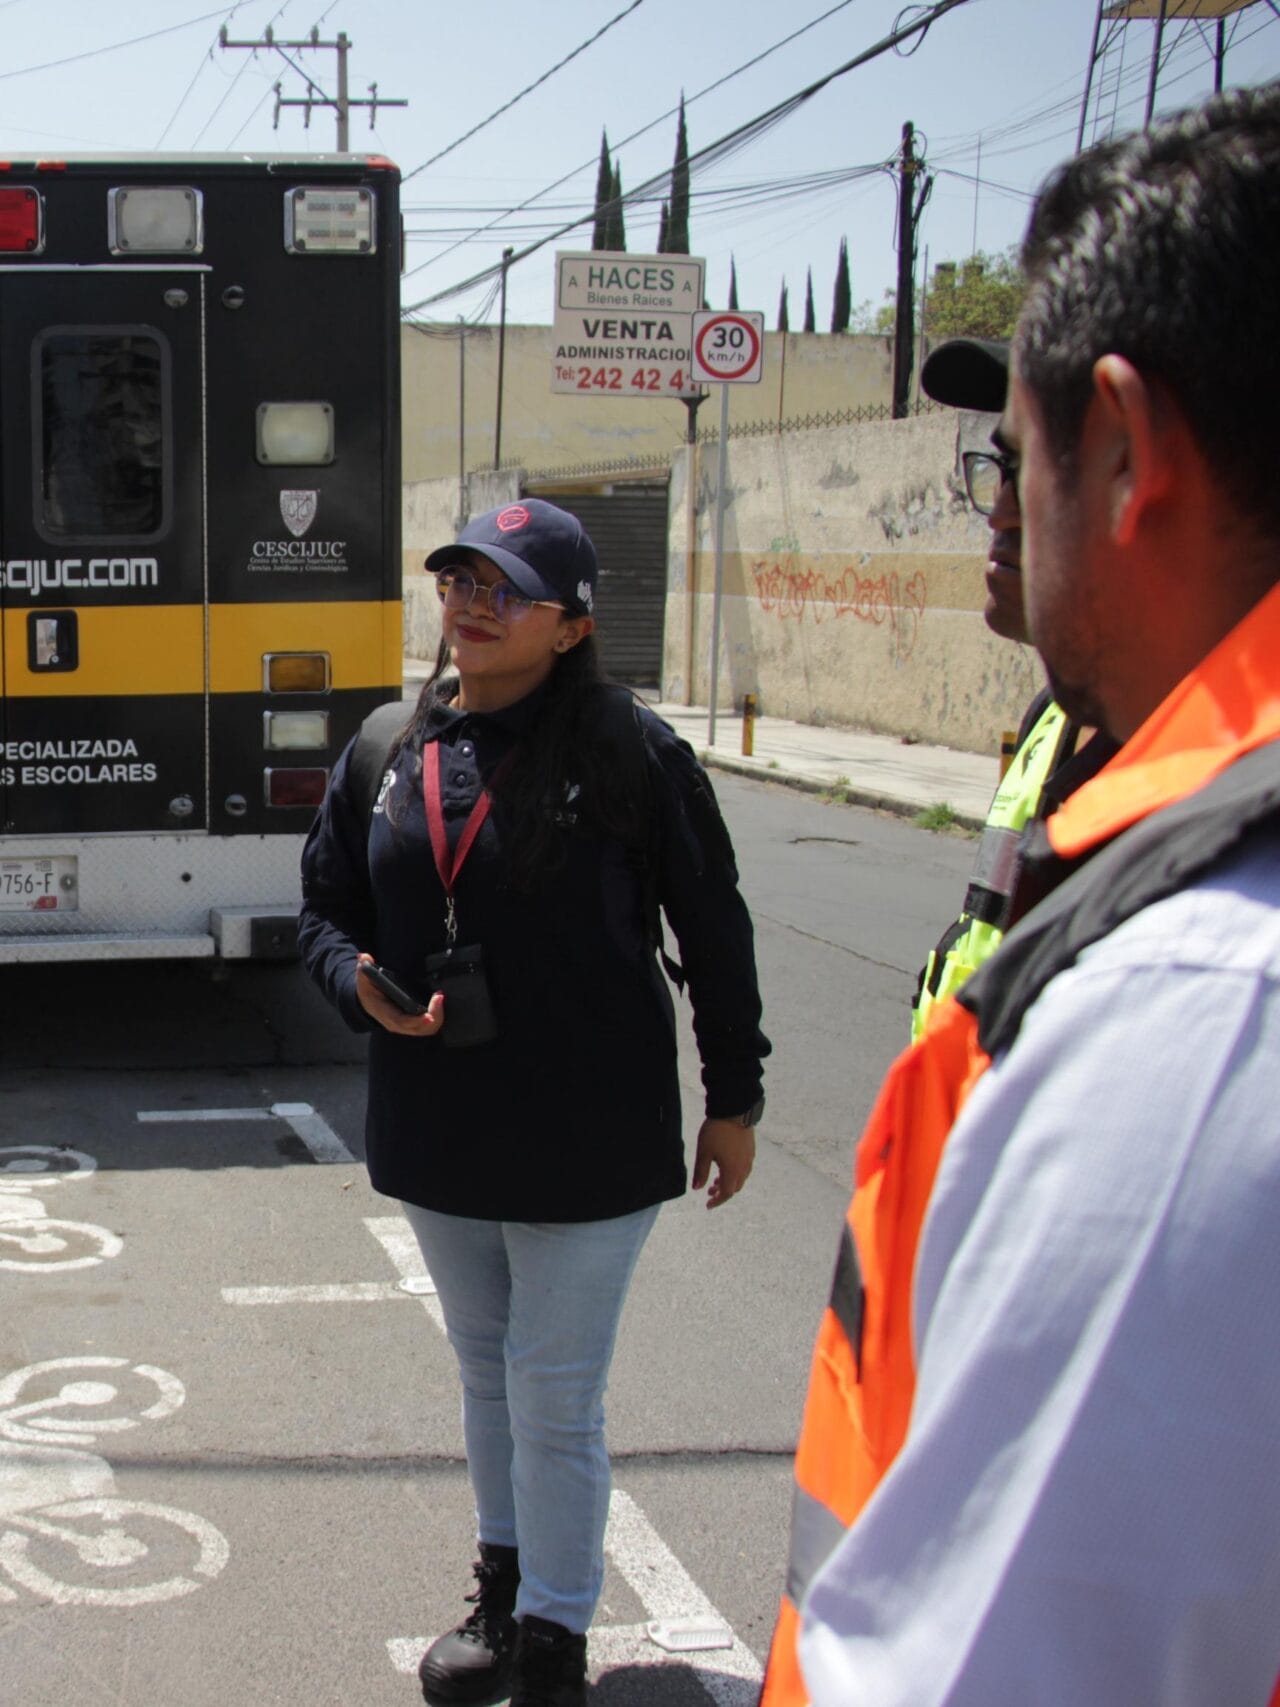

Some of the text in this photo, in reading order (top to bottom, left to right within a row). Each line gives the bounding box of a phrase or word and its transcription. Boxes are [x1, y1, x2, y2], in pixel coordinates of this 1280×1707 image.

[588, 265, 675, 292] HACES
[587, 291, 628, 306] Bienes
[582, 318, 674, 341] VENTA
[711, 327, 745, 349] 30
[707, 351, 745, 363] km/h
[555, 365, 576, 381] Tel:
[577, 366, 623, 391] 242
[631, 368, 661, 391] 42
[252, 541, 344, 557] CESCIJUC
[22, 763, 158, 785] ESCOLARES
